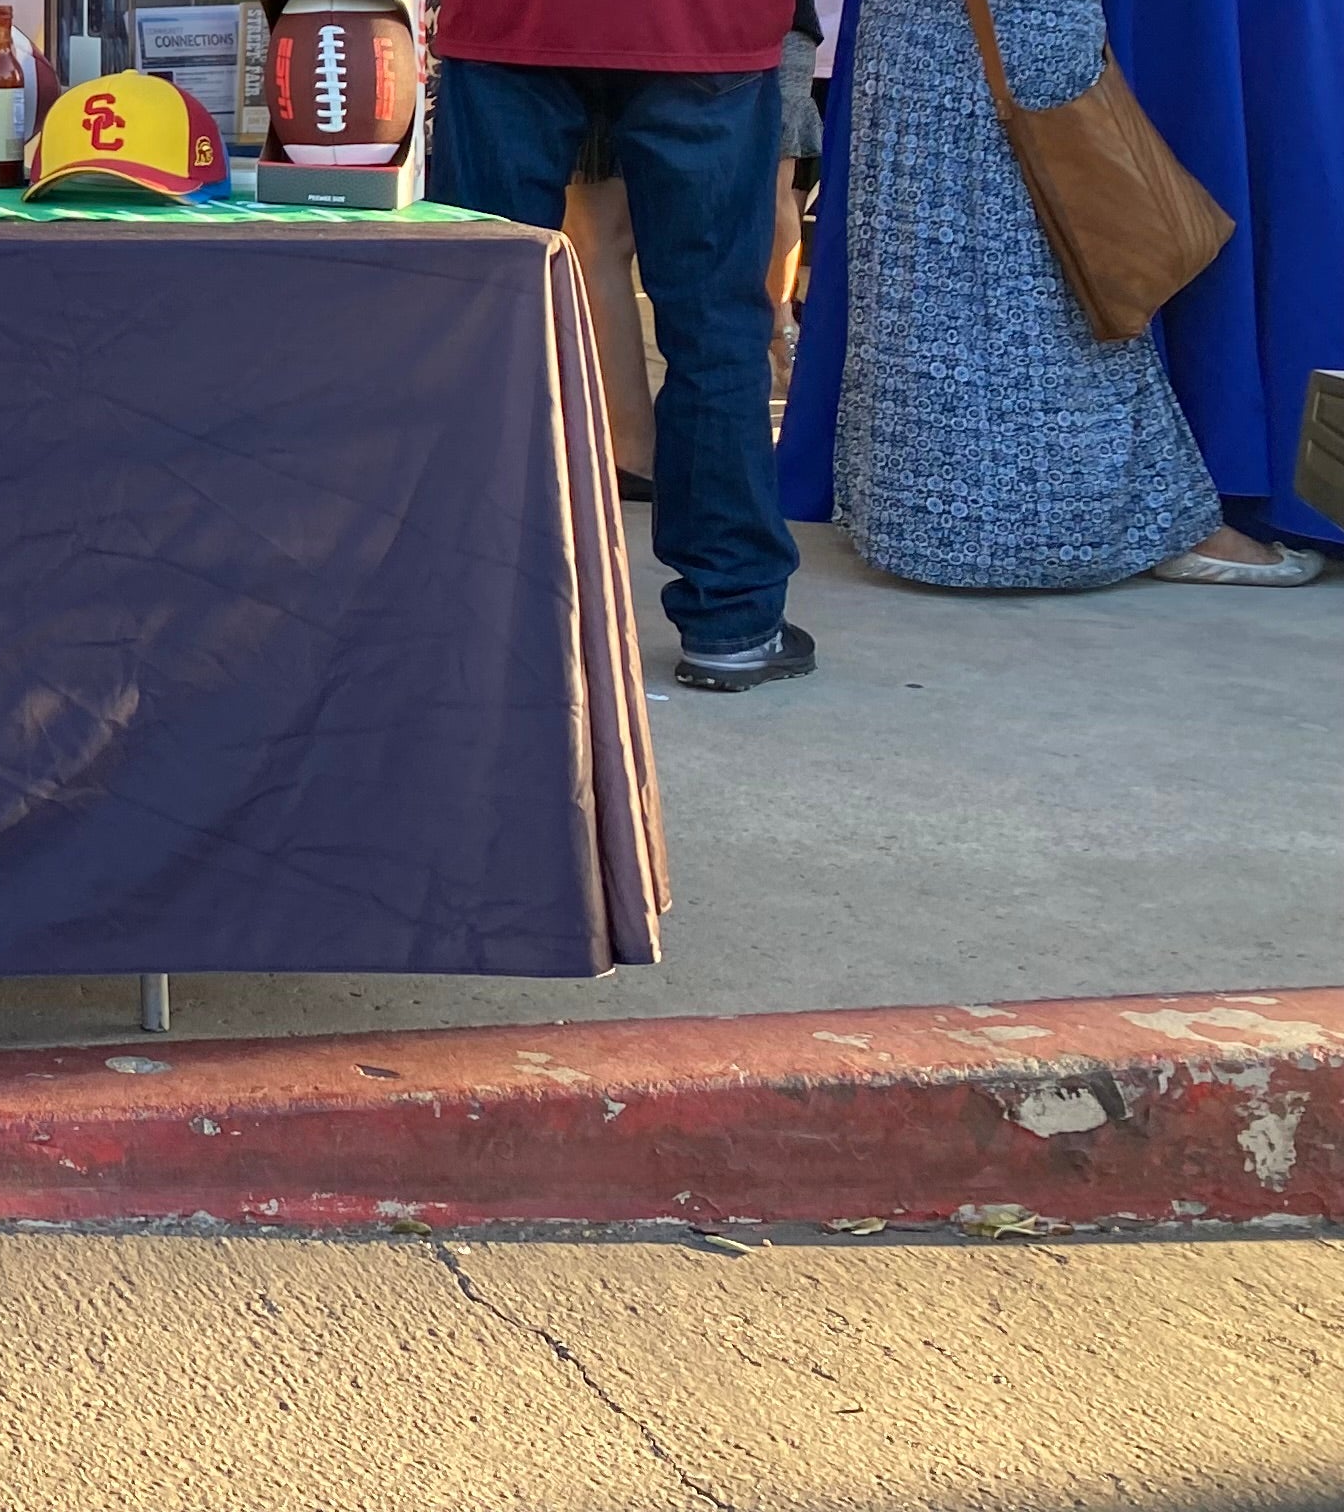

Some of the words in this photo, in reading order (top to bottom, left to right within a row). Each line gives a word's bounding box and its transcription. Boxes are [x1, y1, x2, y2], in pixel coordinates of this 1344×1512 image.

[154, 34, 234, 48] CONNECTIONS
[244, 65, 262, 97] FAIR
[275, 37, 294, 120] ESPN
[82, 93, 126, 152] SC
